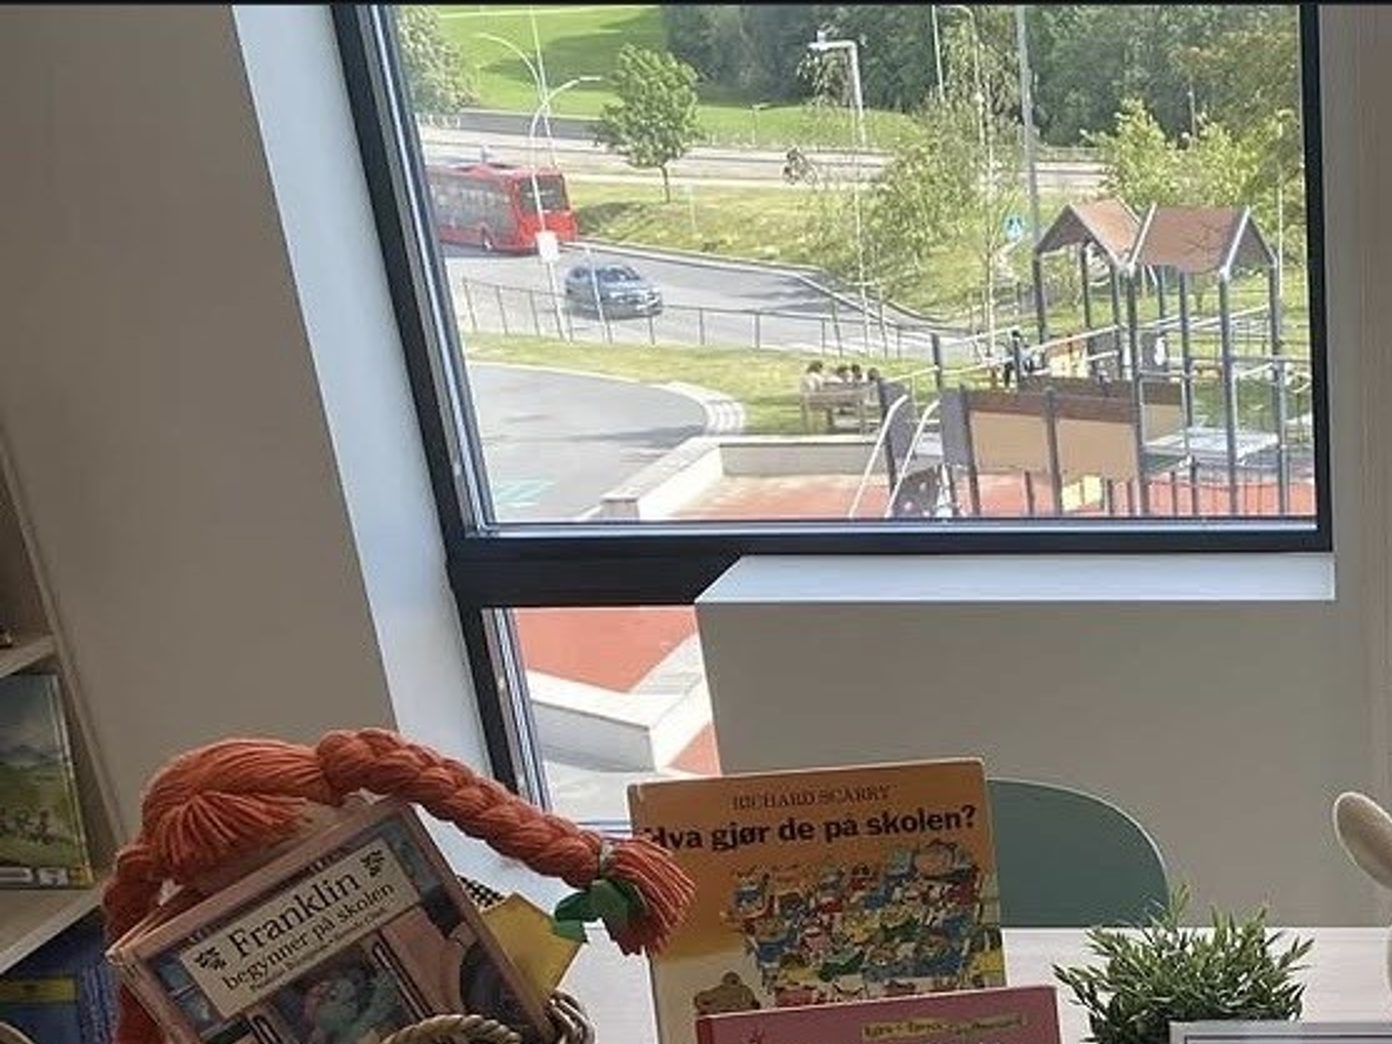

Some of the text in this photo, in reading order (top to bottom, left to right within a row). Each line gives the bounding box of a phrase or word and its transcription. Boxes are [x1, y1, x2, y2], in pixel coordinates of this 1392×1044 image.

[711, 821, 770, 851] gjør
[779, 817, 815, 841] de
[824, 813, 858, 842] på
[865, 804, 977, 836] skolen?
[733, 784, 892, 810] RICHARD SCARRY
[222, 933, 308, 990] begynner
[312, 916, 336, 940] på
[337, 883, 394, 923] skolen
[229, 873, 360, 957] Franklin
